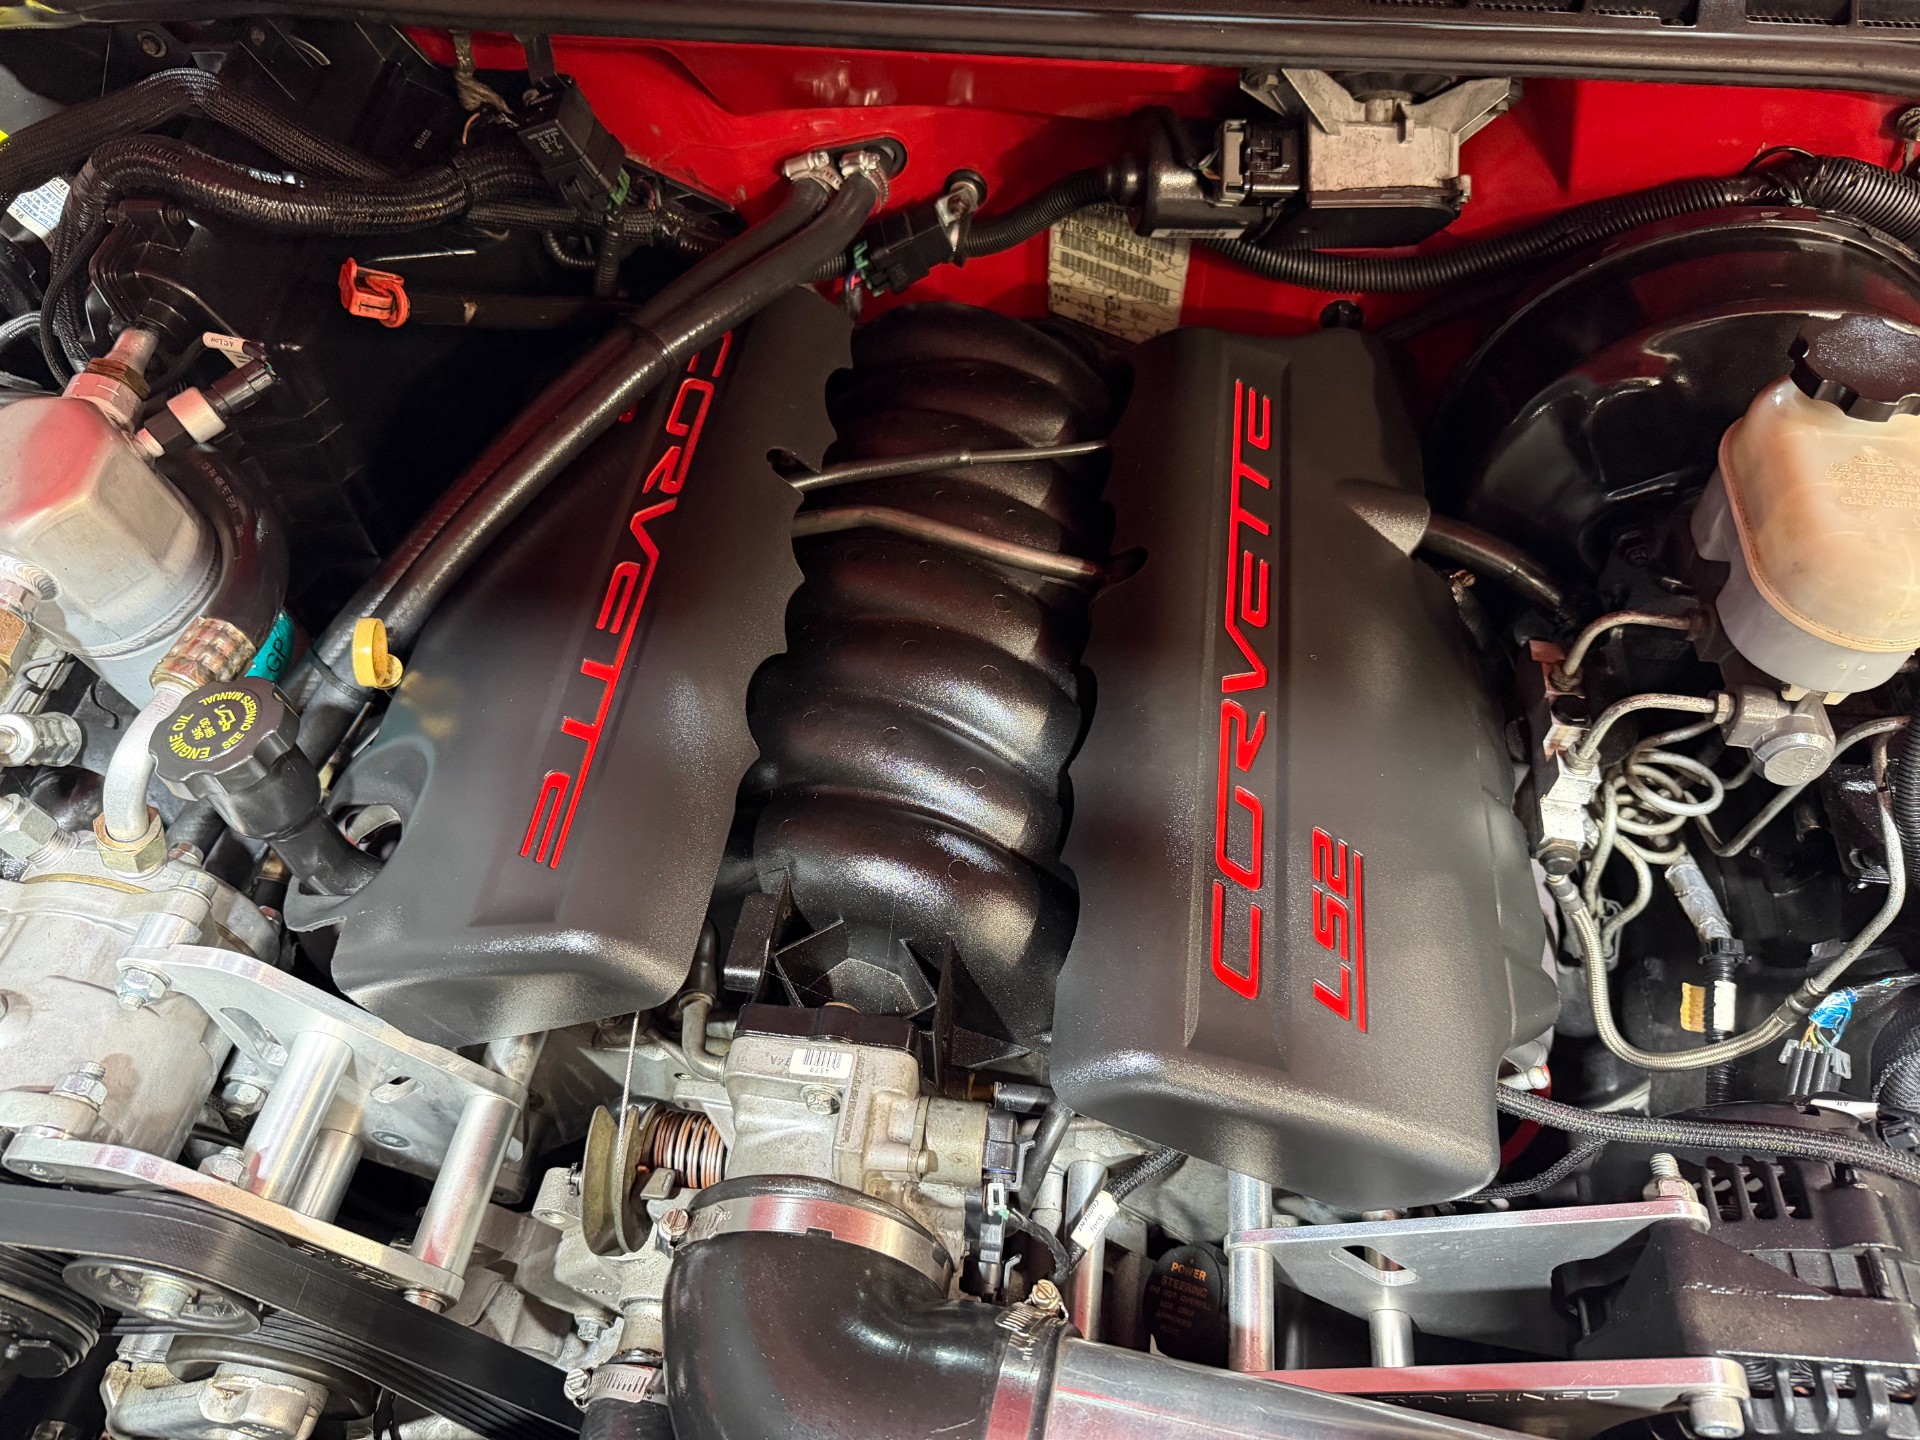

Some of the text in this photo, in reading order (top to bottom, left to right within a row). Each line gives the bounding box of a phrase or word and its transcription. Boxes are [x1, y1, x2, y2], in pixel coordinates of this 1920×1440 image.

[198, 691, 245, 706] MANUAL
[1210, 378, 1271, 1000] CORVETTE
[169, 713, 211, 760] ENGINE OIL
[191, 725, 205, 740] SAE
[221, 731, 245, 749] SEE
[1311, 826, 1351, 1022] LS2
[1170, 1261, 1207, 1282] POWER
[1160, 1275, 1208, 1297] STEERING
